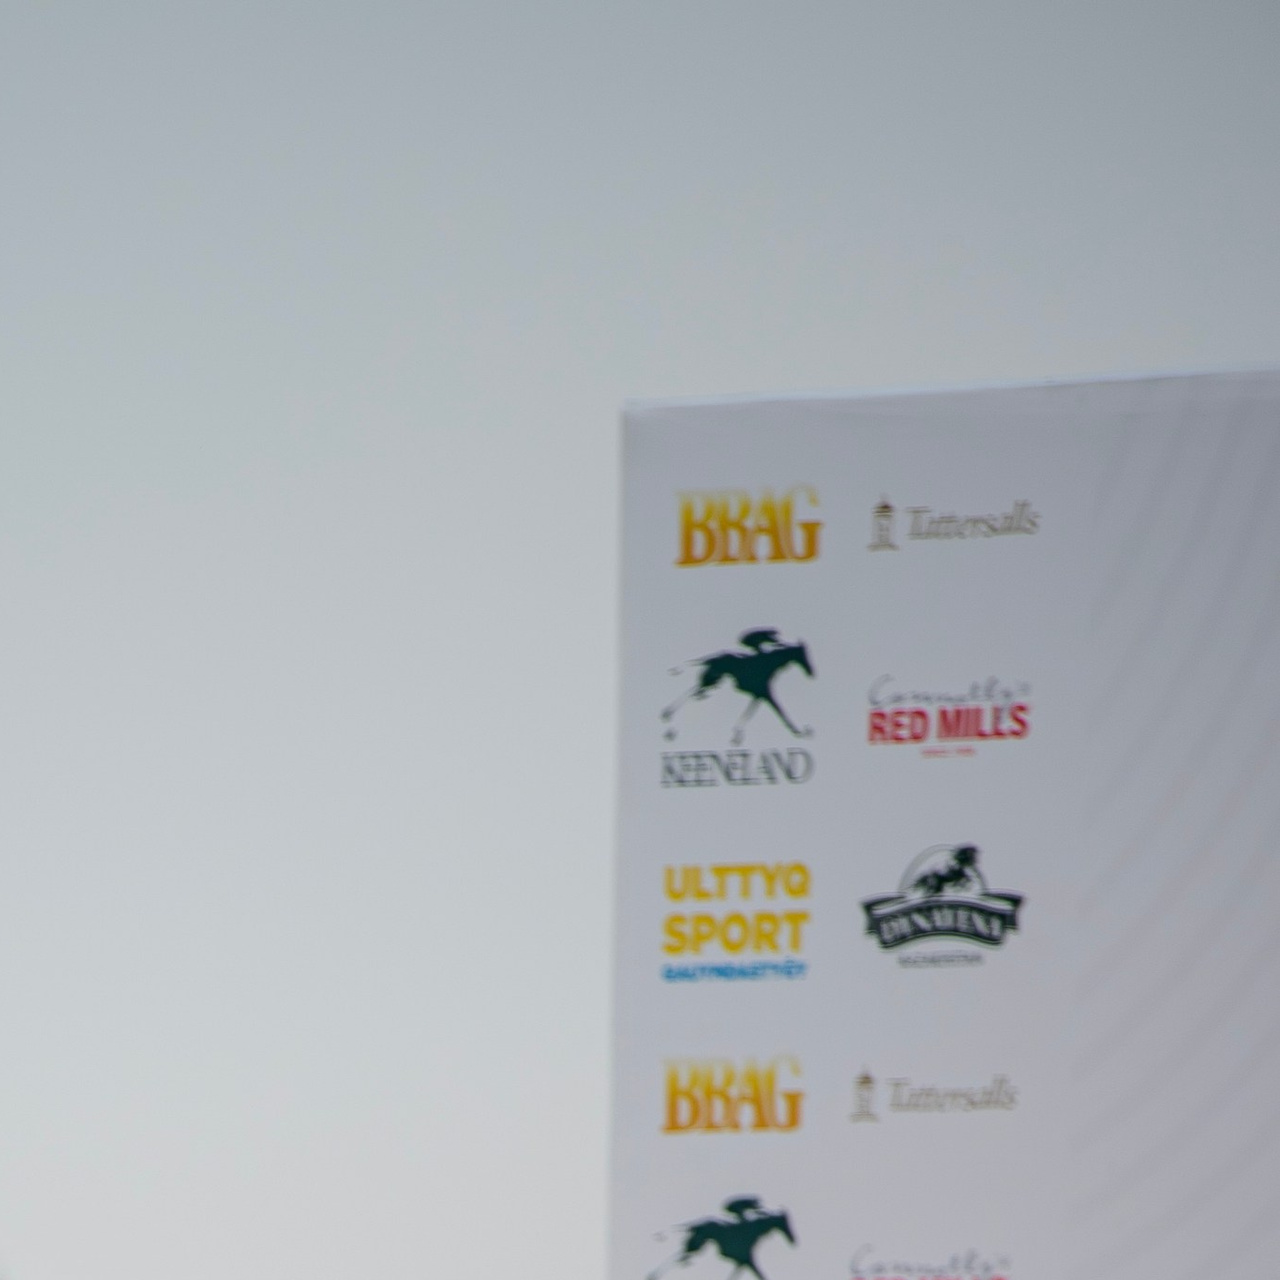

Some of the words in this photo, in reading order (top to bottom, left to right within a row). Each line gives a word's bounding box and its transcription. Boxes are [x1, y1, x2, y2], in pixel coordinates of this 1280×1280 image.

[869, 709, 929, 744] RED
[937, 703, 1029, 742] MILLS
[663, 911, 810, 956] SPORT
